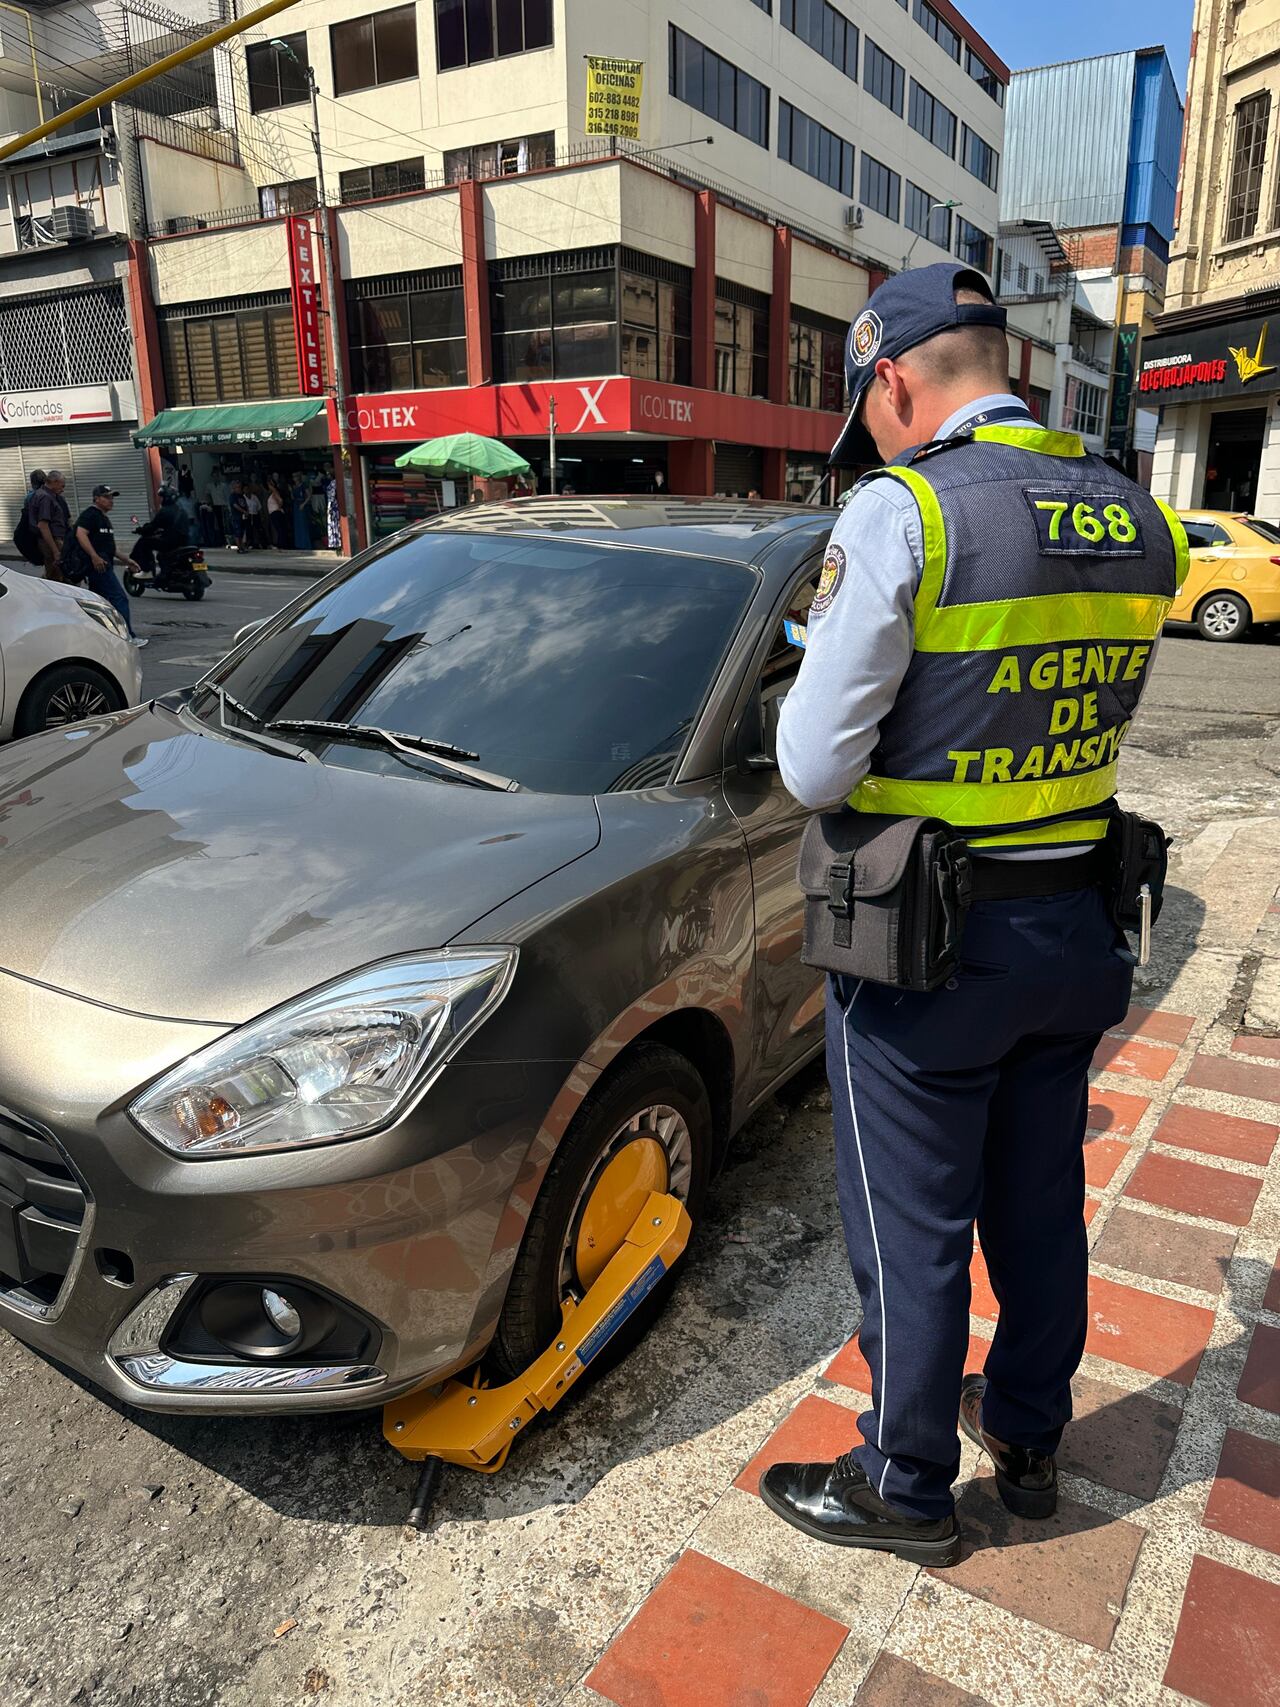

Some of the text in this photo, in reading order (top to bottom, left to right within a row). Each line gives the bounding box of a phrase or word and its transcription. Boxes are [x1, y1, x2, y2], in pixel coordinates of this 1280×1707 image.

[589, 58, 641, 75] SE ALQUILAN
[595, 73, 636, 89] OFICINAS
[589, 92, 640, 108] 602-883 4482
[588, 107, 603, 119] 315
[588, 122, 602, 134] 316
[298, 224, 319, 388] TEXTILES
[1143, 353, 1192, 370] DISTRIBUIDORA
[1139, 359, 1228, 391] ELECTROJAPONES
[7, 399, 63, 417] Colfondos
[640, 395, 692, 422] ICOLTEX
[342, 406, 416, 430] COLTEX
[1034, 501, 1137, 543] 768
[1048, 692, 1099, 736] DE
